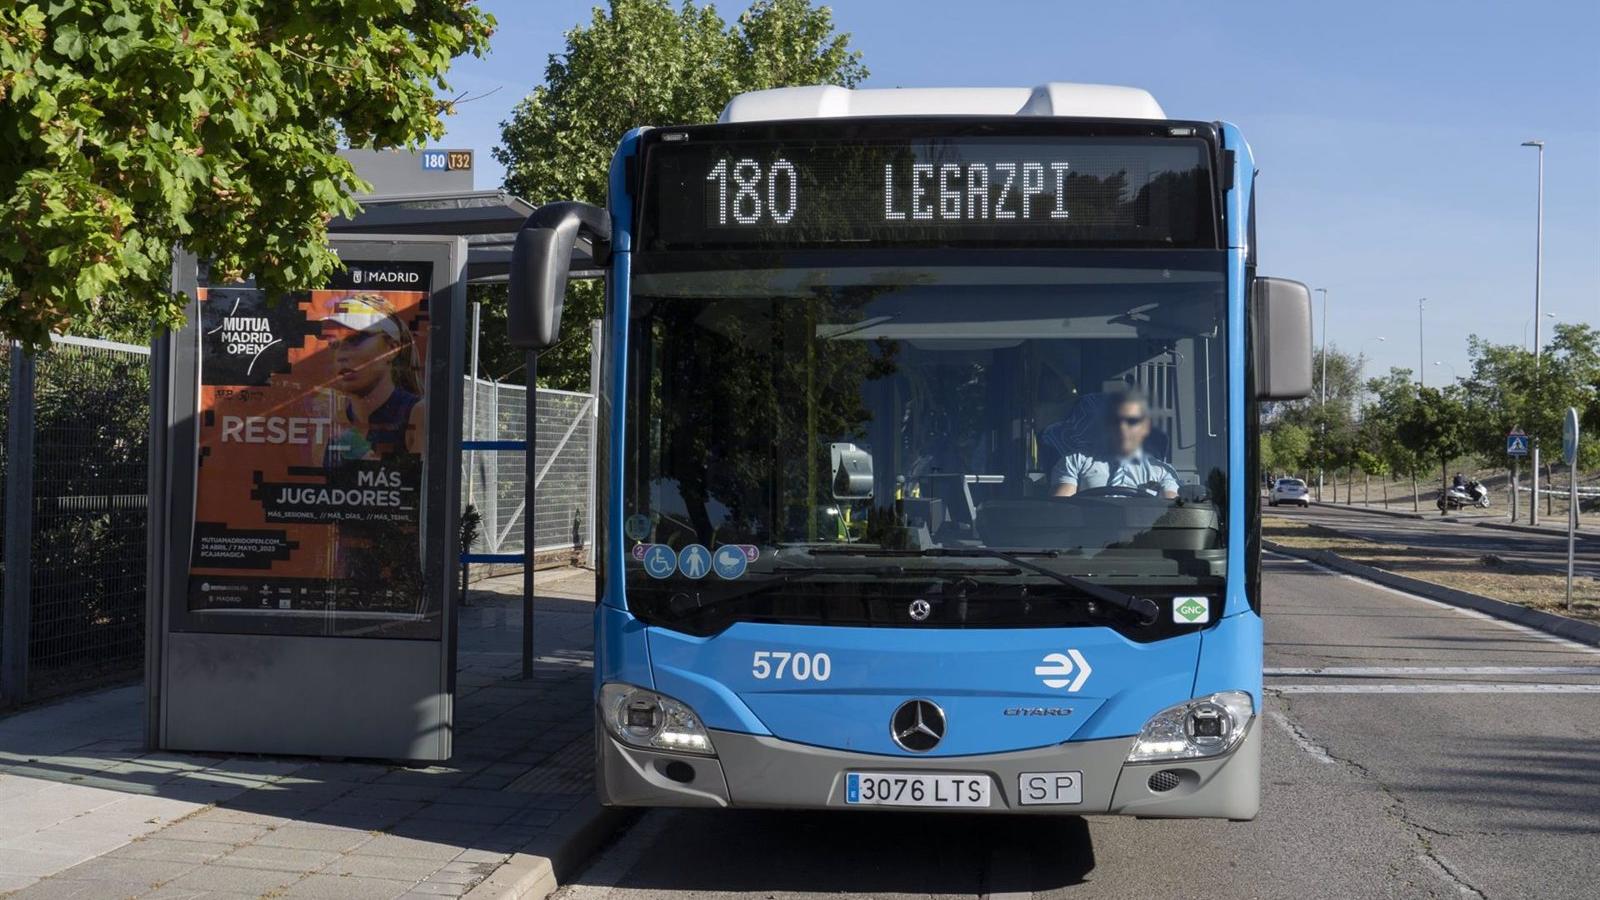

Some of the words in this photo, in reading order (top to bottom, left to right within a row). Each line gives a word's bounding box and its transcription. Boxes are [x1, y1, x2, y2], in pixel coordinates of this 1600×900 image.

[424, 154, 445, 168] 180
[450, 154, 470, 168] T32
[706, 158, 798, 225] 180
[884, 162, 1070, 220] LEGAZPI
[368, 271, 419, 283] MADRID
[223, 317, 270, 332] MUTUA
[221, 332, 273, 343] MADRID
[227, 344, 264, 355] OPEN
[1180, 606, 1201, 615] GNC
[752, 652, 831, 682] 5700
[1003, 707, 1075, 717] CITARO
[861, 777, 925, 802] 3076
[934, 778, 982, 803] LTS
[1028, 776, 1074, 800] SP
